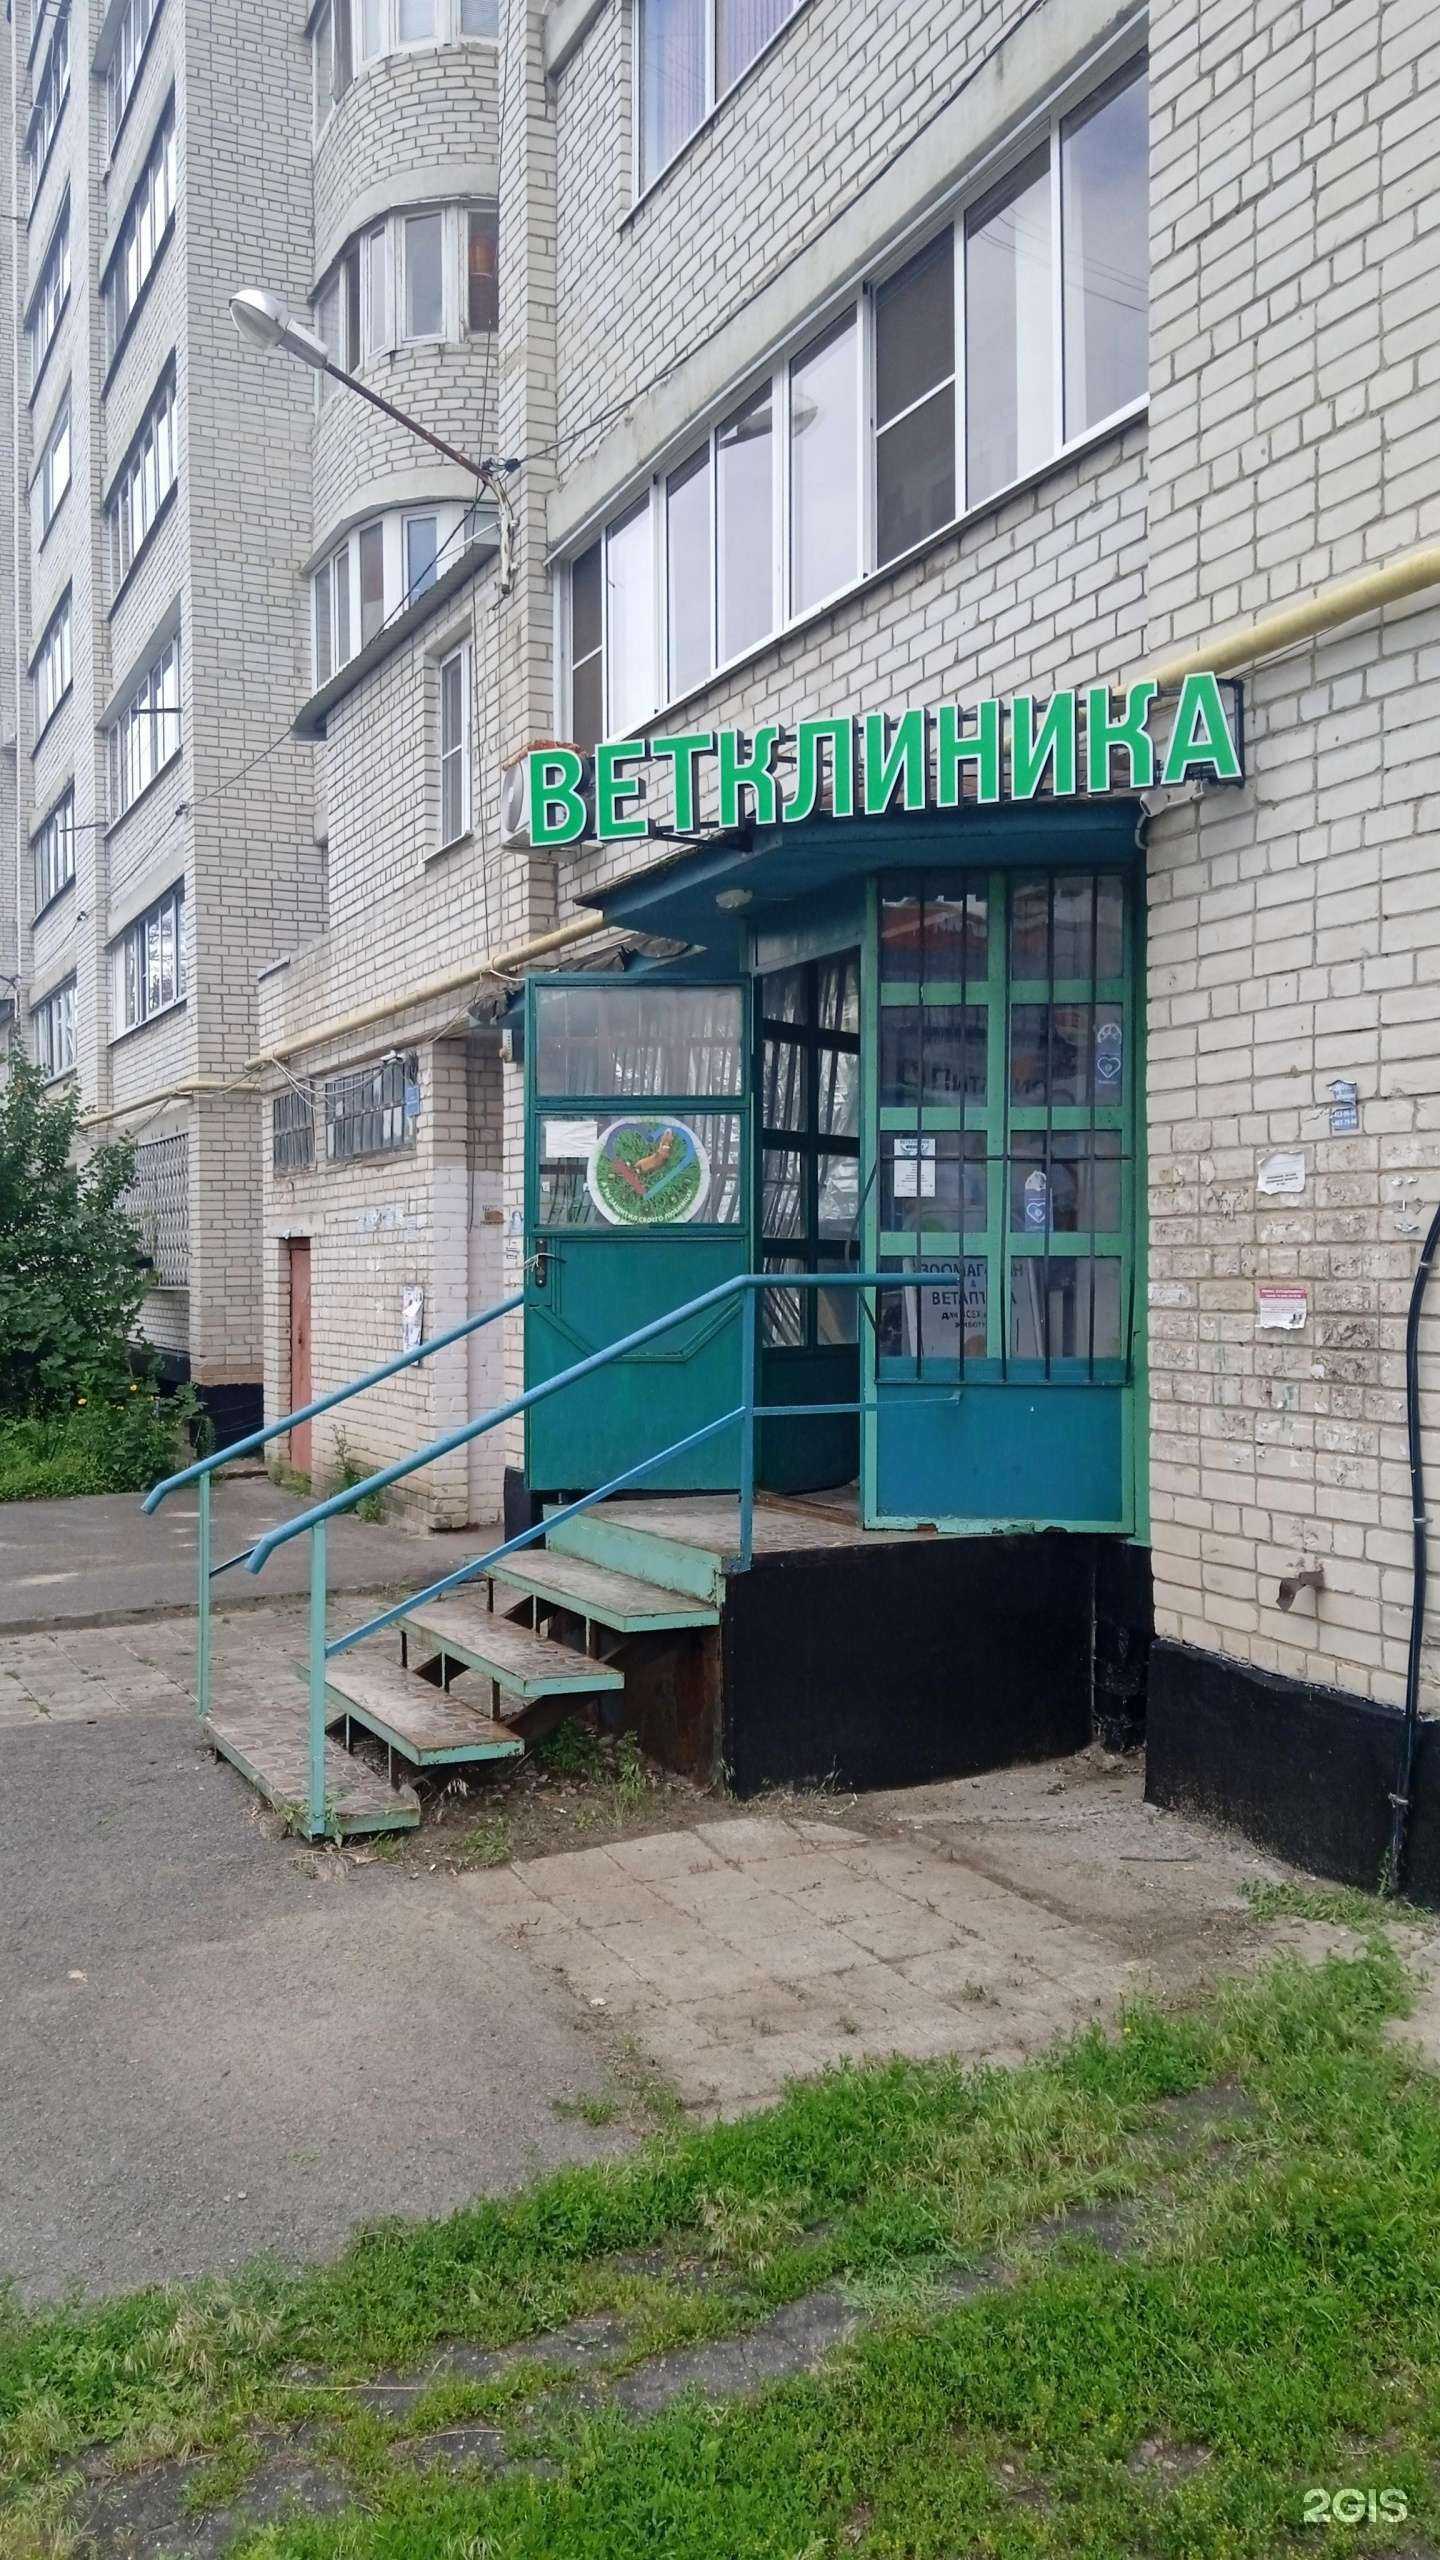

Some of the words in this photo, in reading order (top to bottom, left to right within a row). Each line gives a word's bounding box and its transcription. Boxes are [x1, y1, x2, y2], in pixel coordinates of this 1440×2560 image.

[528, 671, 1243, 847] ВЕТКЛИНИКА
[921, 1263, 1023, 1277] ЗООМАГН
[932, 1291, 1017, 1305] ВЕТАПТА
